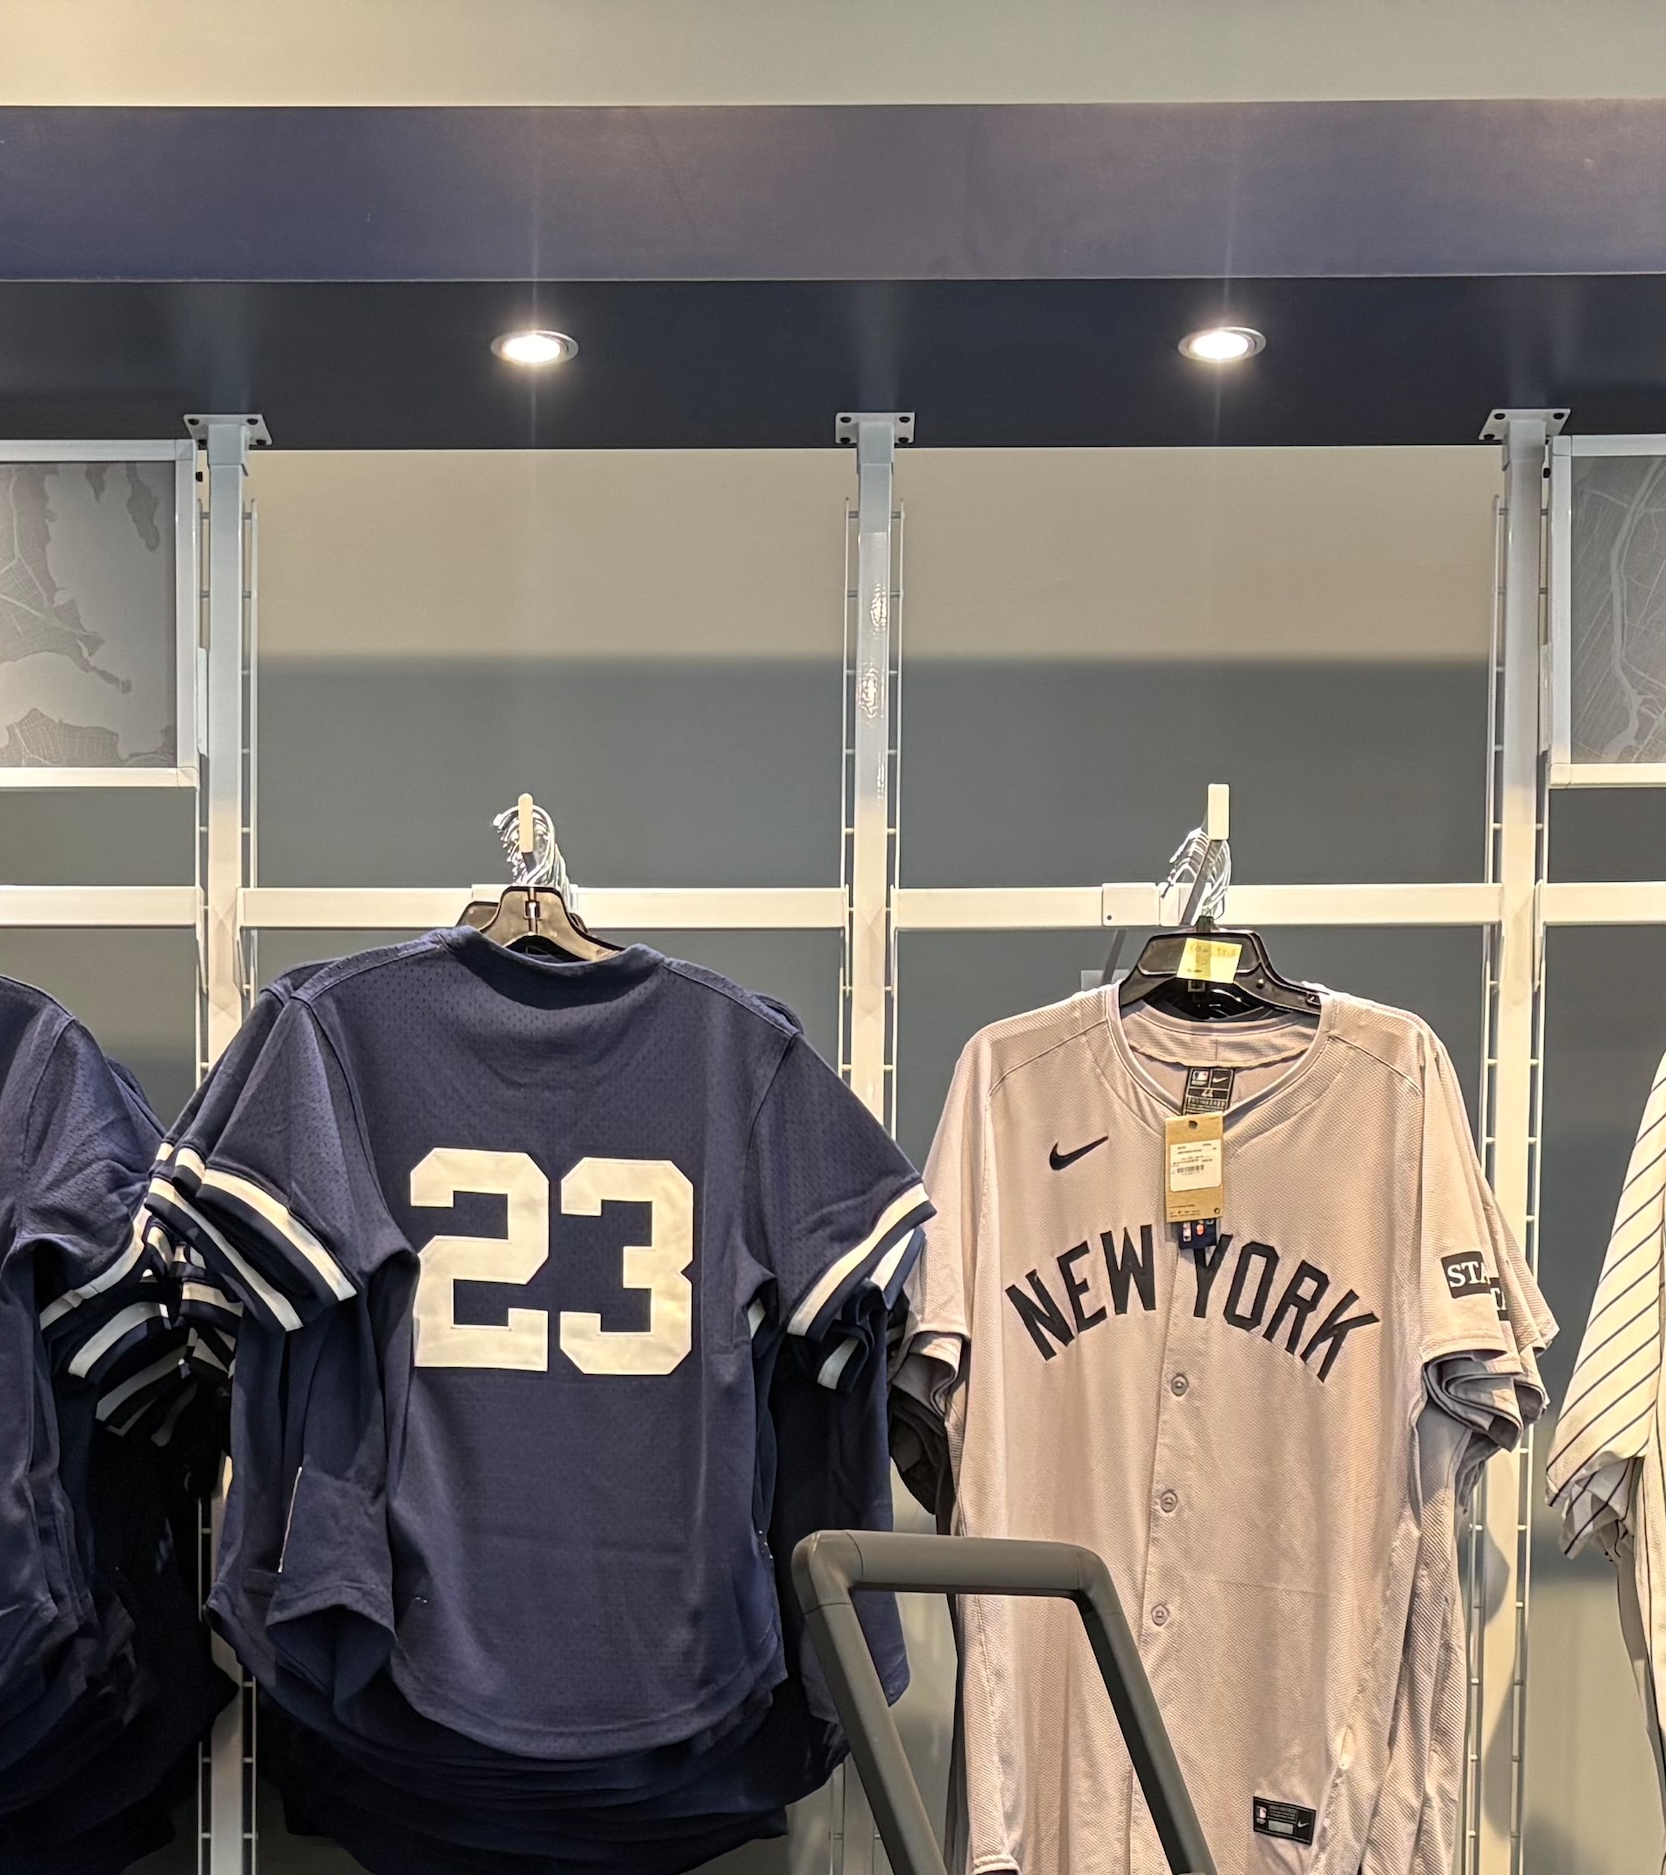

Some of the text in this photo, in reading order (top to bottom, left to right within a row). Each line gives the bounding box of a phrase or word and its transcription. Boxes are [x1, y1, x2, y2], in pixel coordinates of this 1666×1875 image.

[410, 1148, 694, 1376] 23
[1005, 1224, 1380, 1383] NEW YORK
